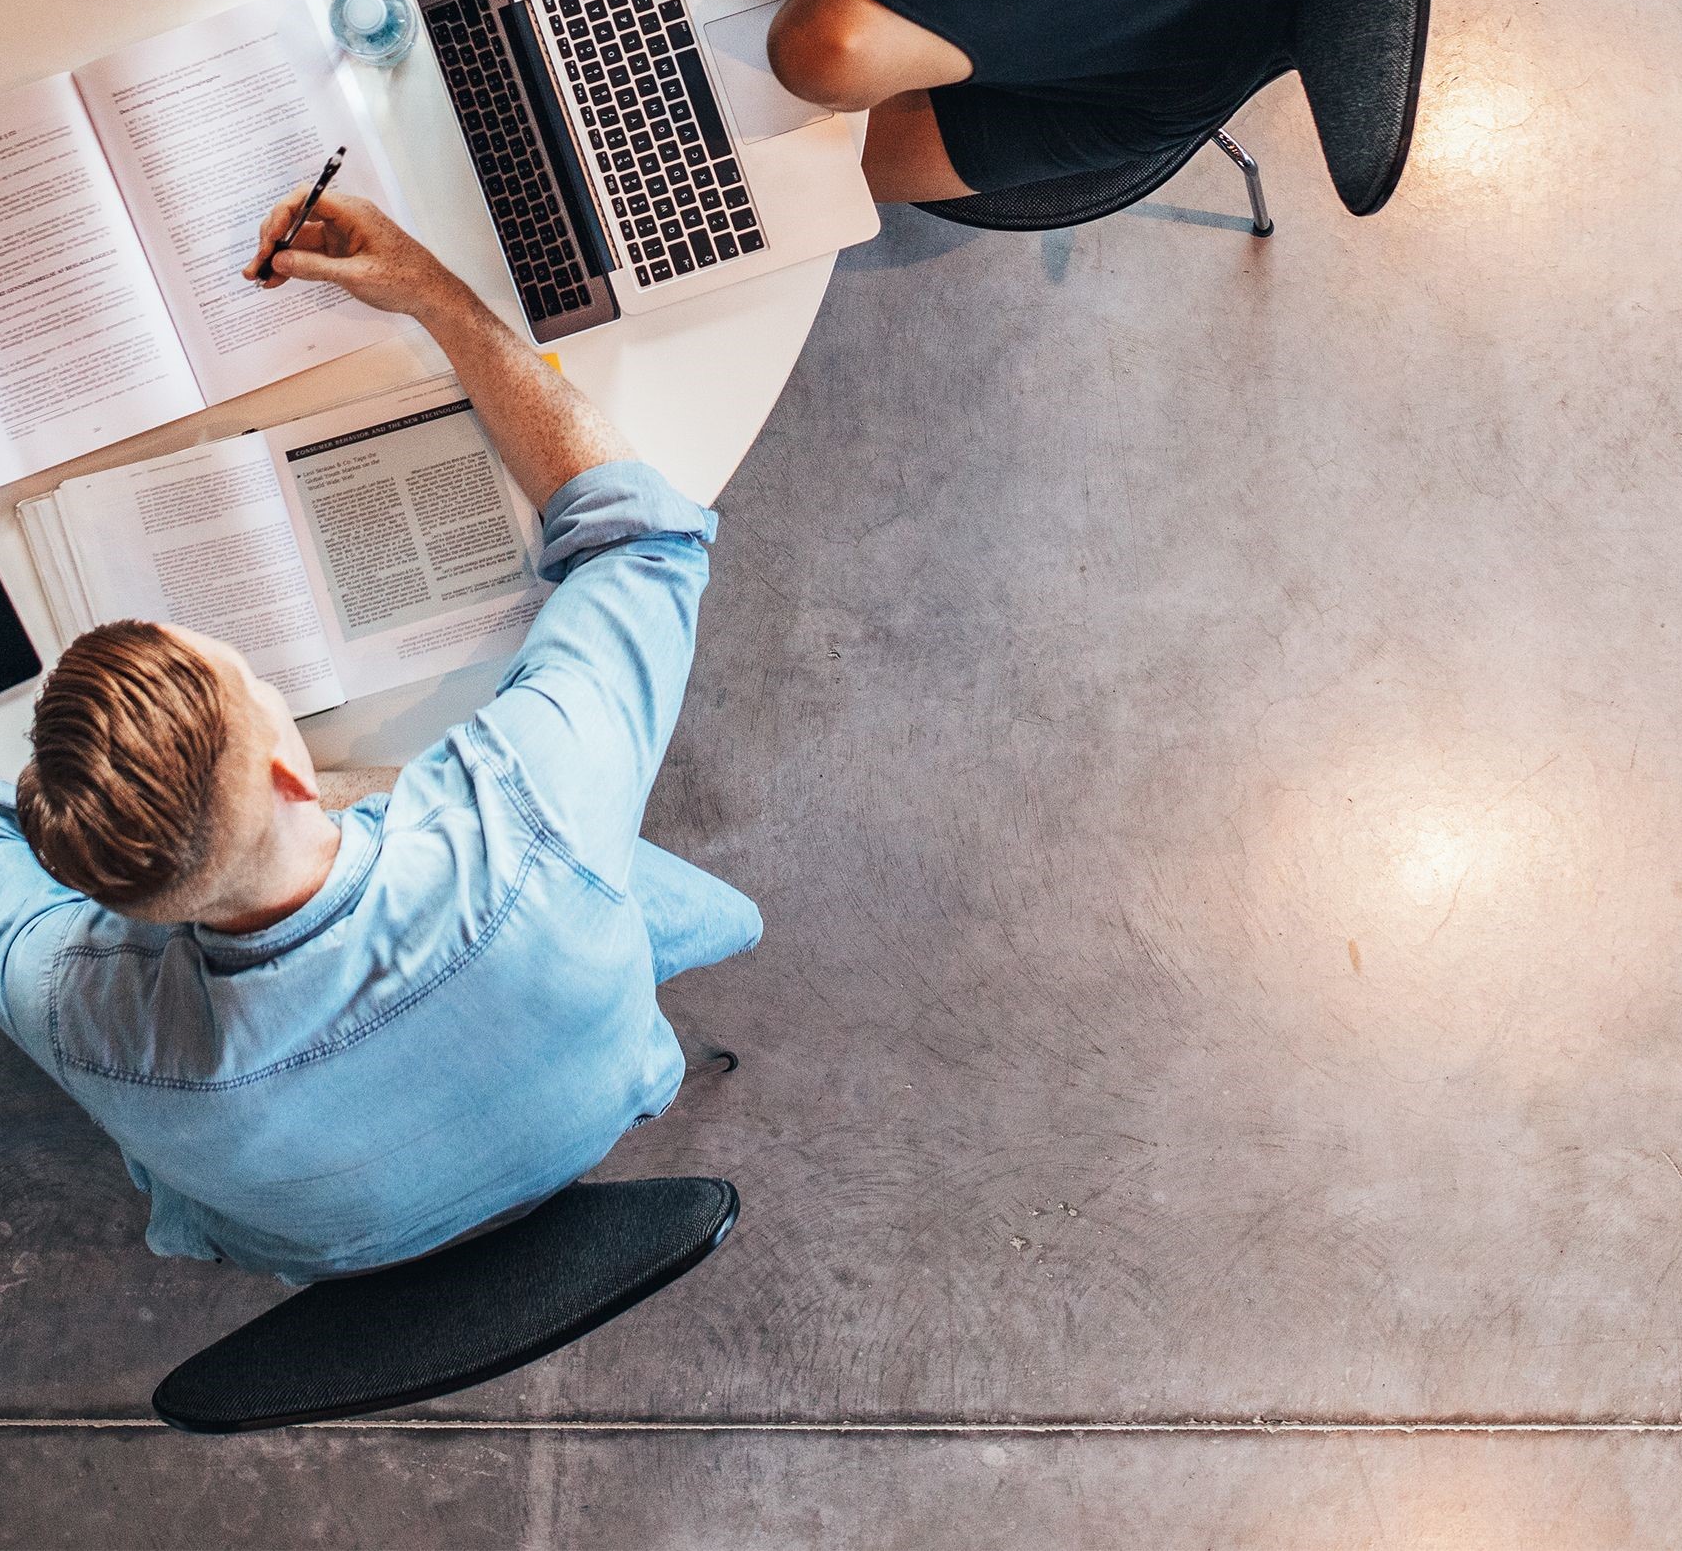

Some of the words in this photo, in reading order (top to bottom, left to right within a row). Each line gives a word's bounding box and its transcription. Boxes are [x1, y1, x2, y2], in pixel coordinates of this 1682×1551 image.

[591, 6, 601, 14] Å
[607, 50, 616, 59] O
[635, 59, 643, 68] K
[660, 63, 670, 72] M
[668, 85, 677, 94] N
[622, 94, 631, 103] U
[650, 103, 659, 112] H
[676, 107, 685, 115] B
[657, 125, 666, 134] G
[683, 130, 692, 138] V
[690, 151, 700, 159] C
[645, 160, 653, 168] R
[673, 169, 682, 178] D
[698, 173, 707, 181] X
[706, 195, 715, 203] Z
[659, 204, 669, 213] W
[667, 226, 676, 234] Q
[294, 441, 333, 456] CONSUMER
[334, 430, 369, 445] BEHAVIOR
[371, 426, 385, 434] AND
[387, 421, 401, 429] THE
[403, 416, 418, 425] NEW
